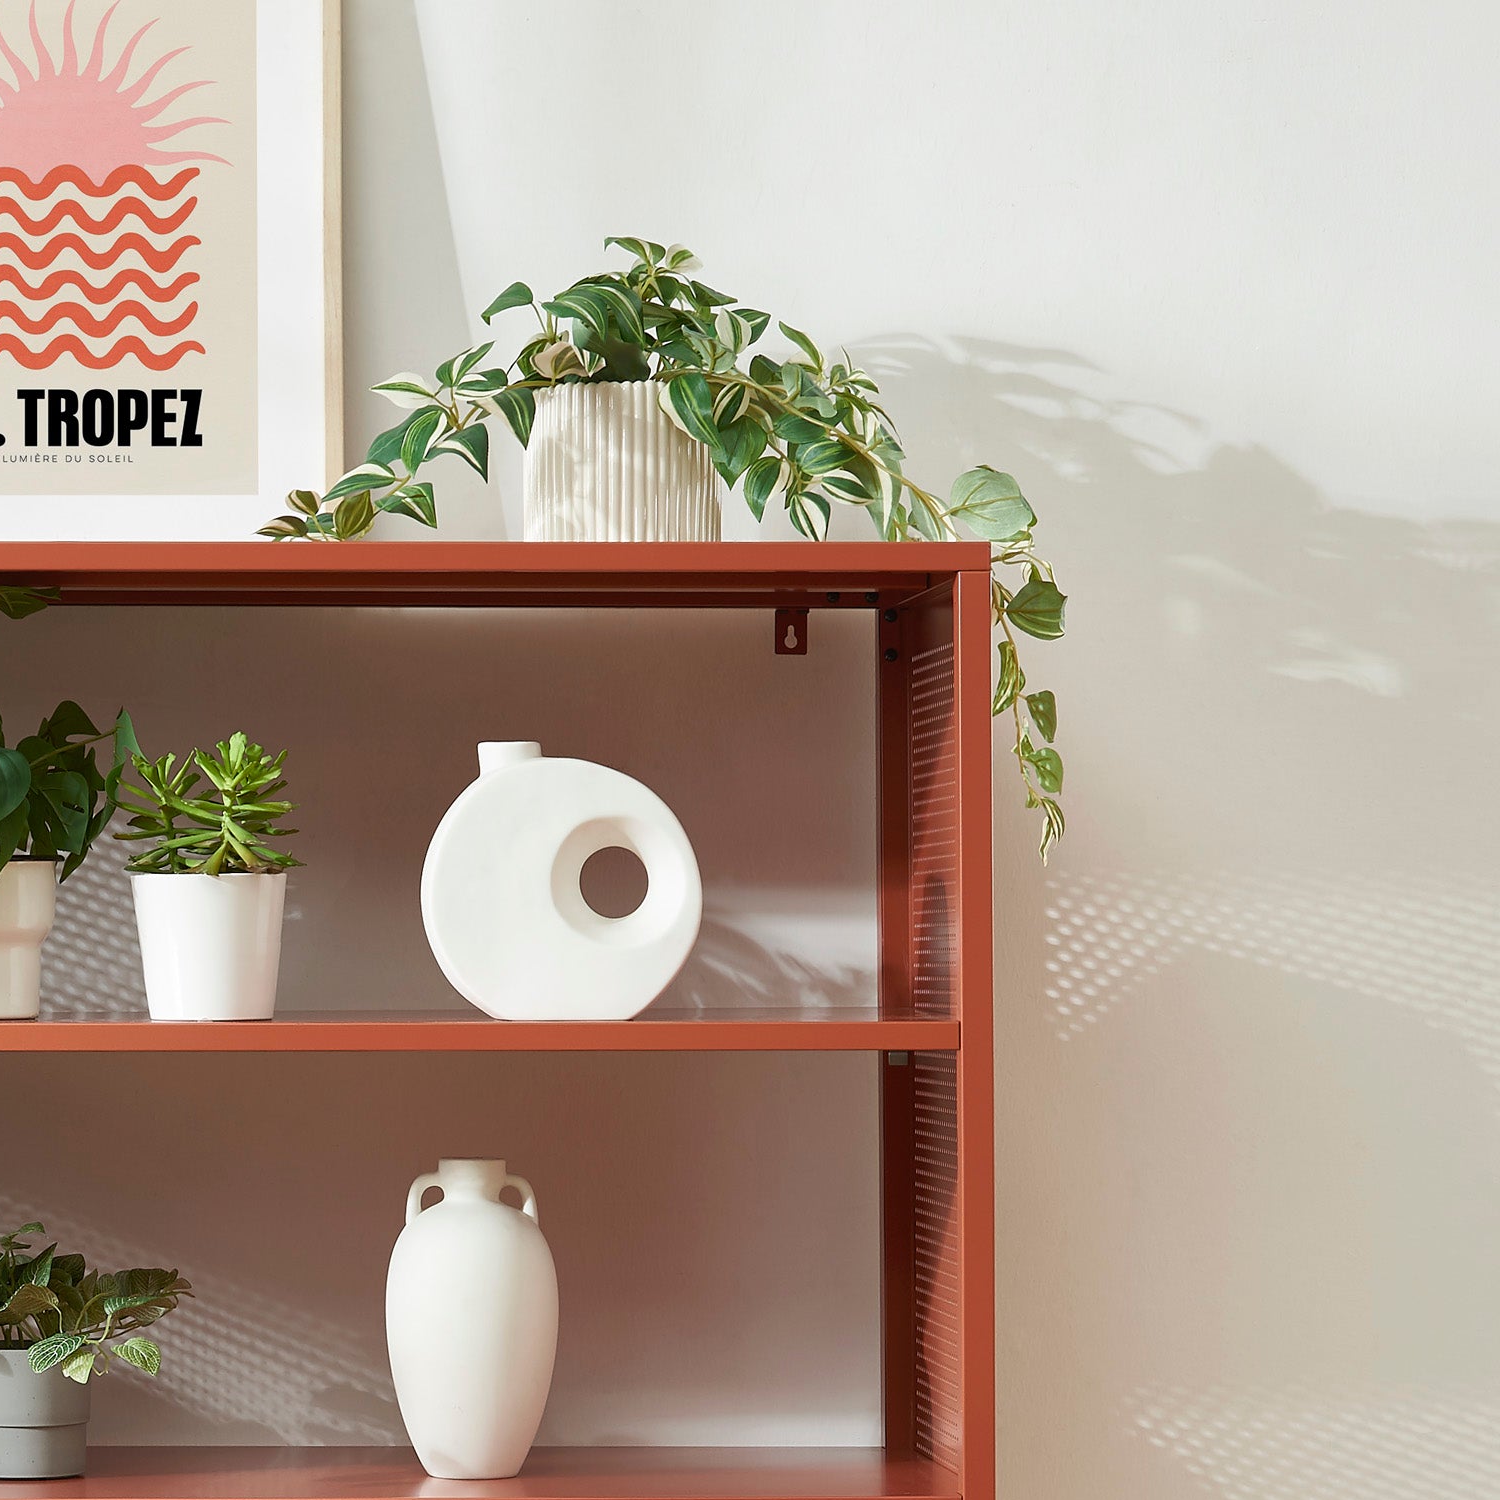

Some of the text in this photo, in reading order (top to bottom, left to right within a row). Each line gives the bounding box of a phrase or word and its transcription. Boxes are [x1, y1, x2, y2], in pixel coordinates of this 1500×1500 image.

[17, 388, 203, 447] TROPEZ
[2, 453, 134, 463] LUMIÈRE DU SOLEIL
